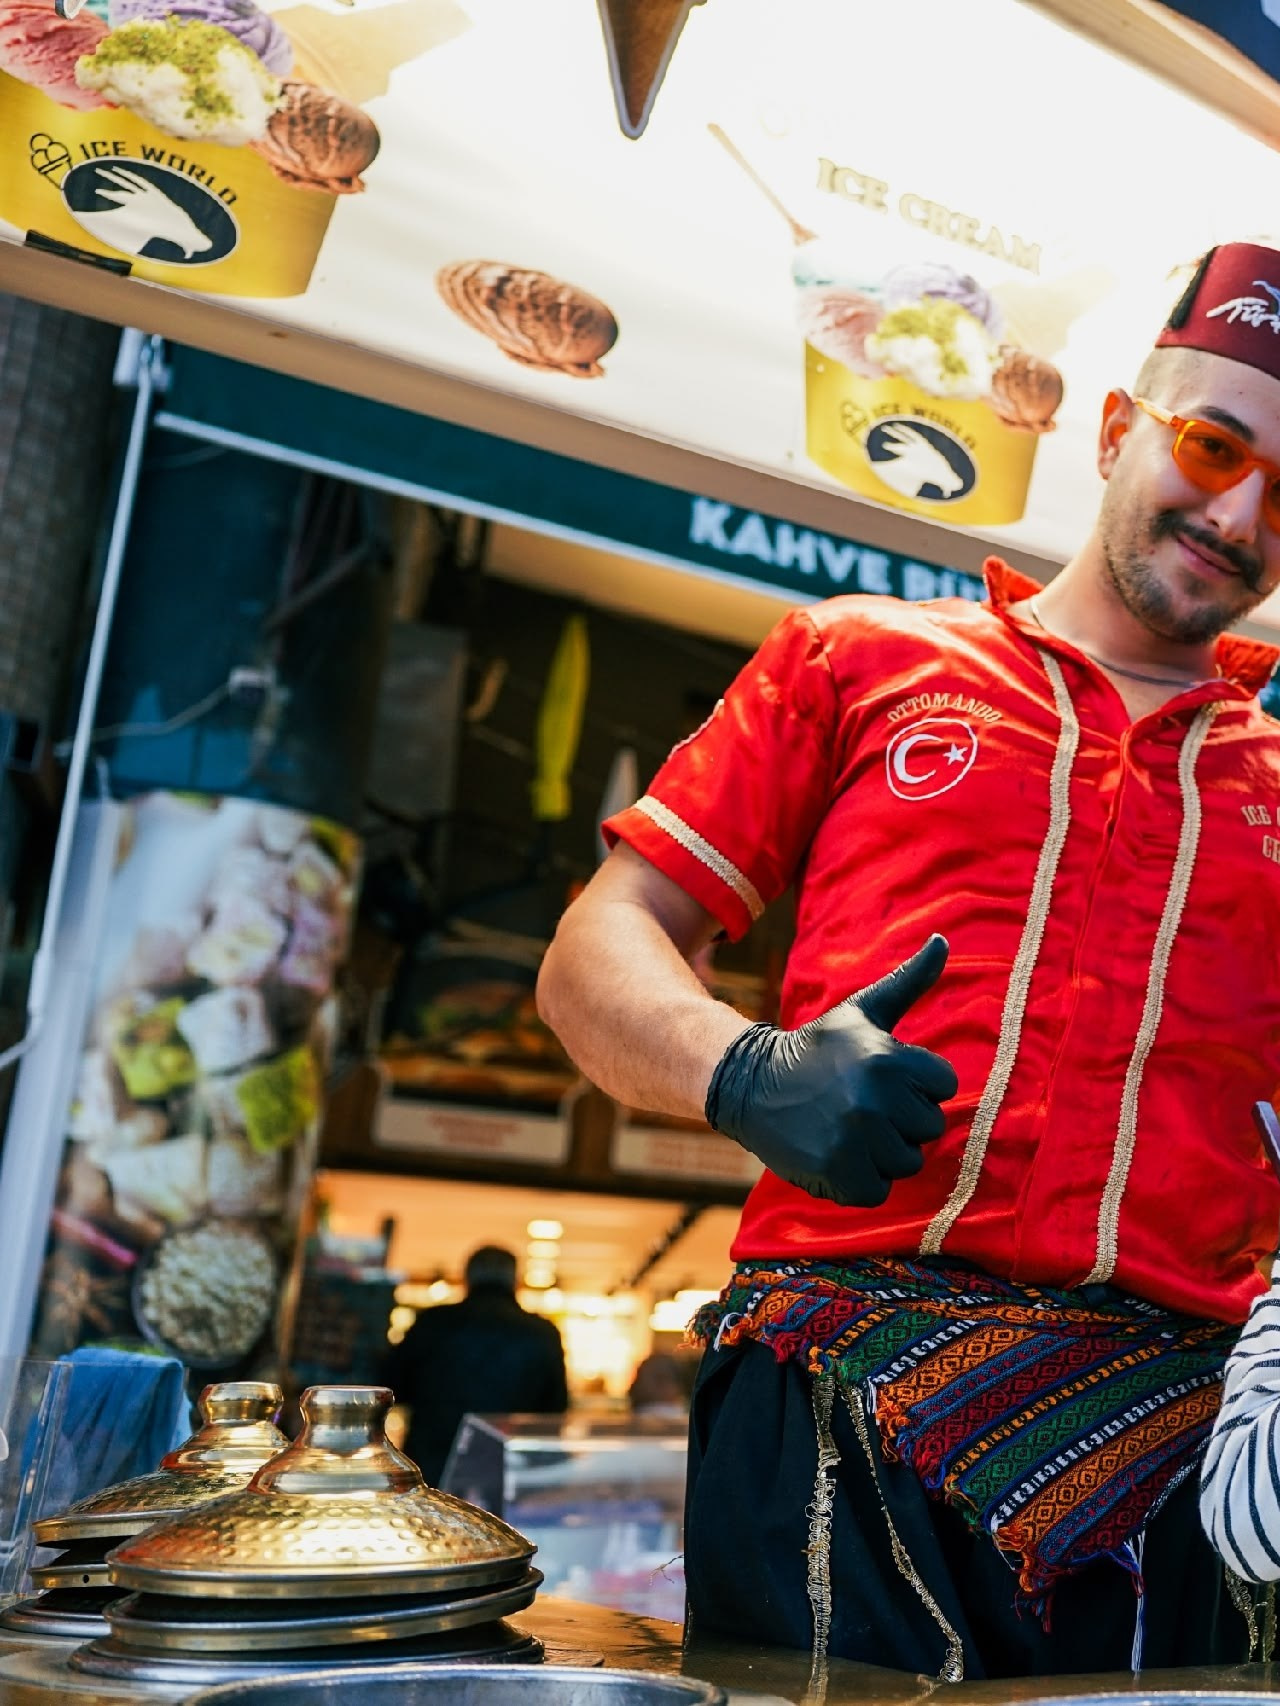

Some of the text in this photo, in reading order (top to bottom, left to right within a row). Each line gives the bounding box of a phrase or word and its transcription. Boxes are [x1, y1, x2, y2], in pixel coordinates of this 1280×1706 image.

[79, 140, 238, 206] ICE WORLD
[816, 157, 1042, 276] ICE CREAM
[689, 496, 893, 595] KAHVE
[1240, 804, 1272, 827] ICE
